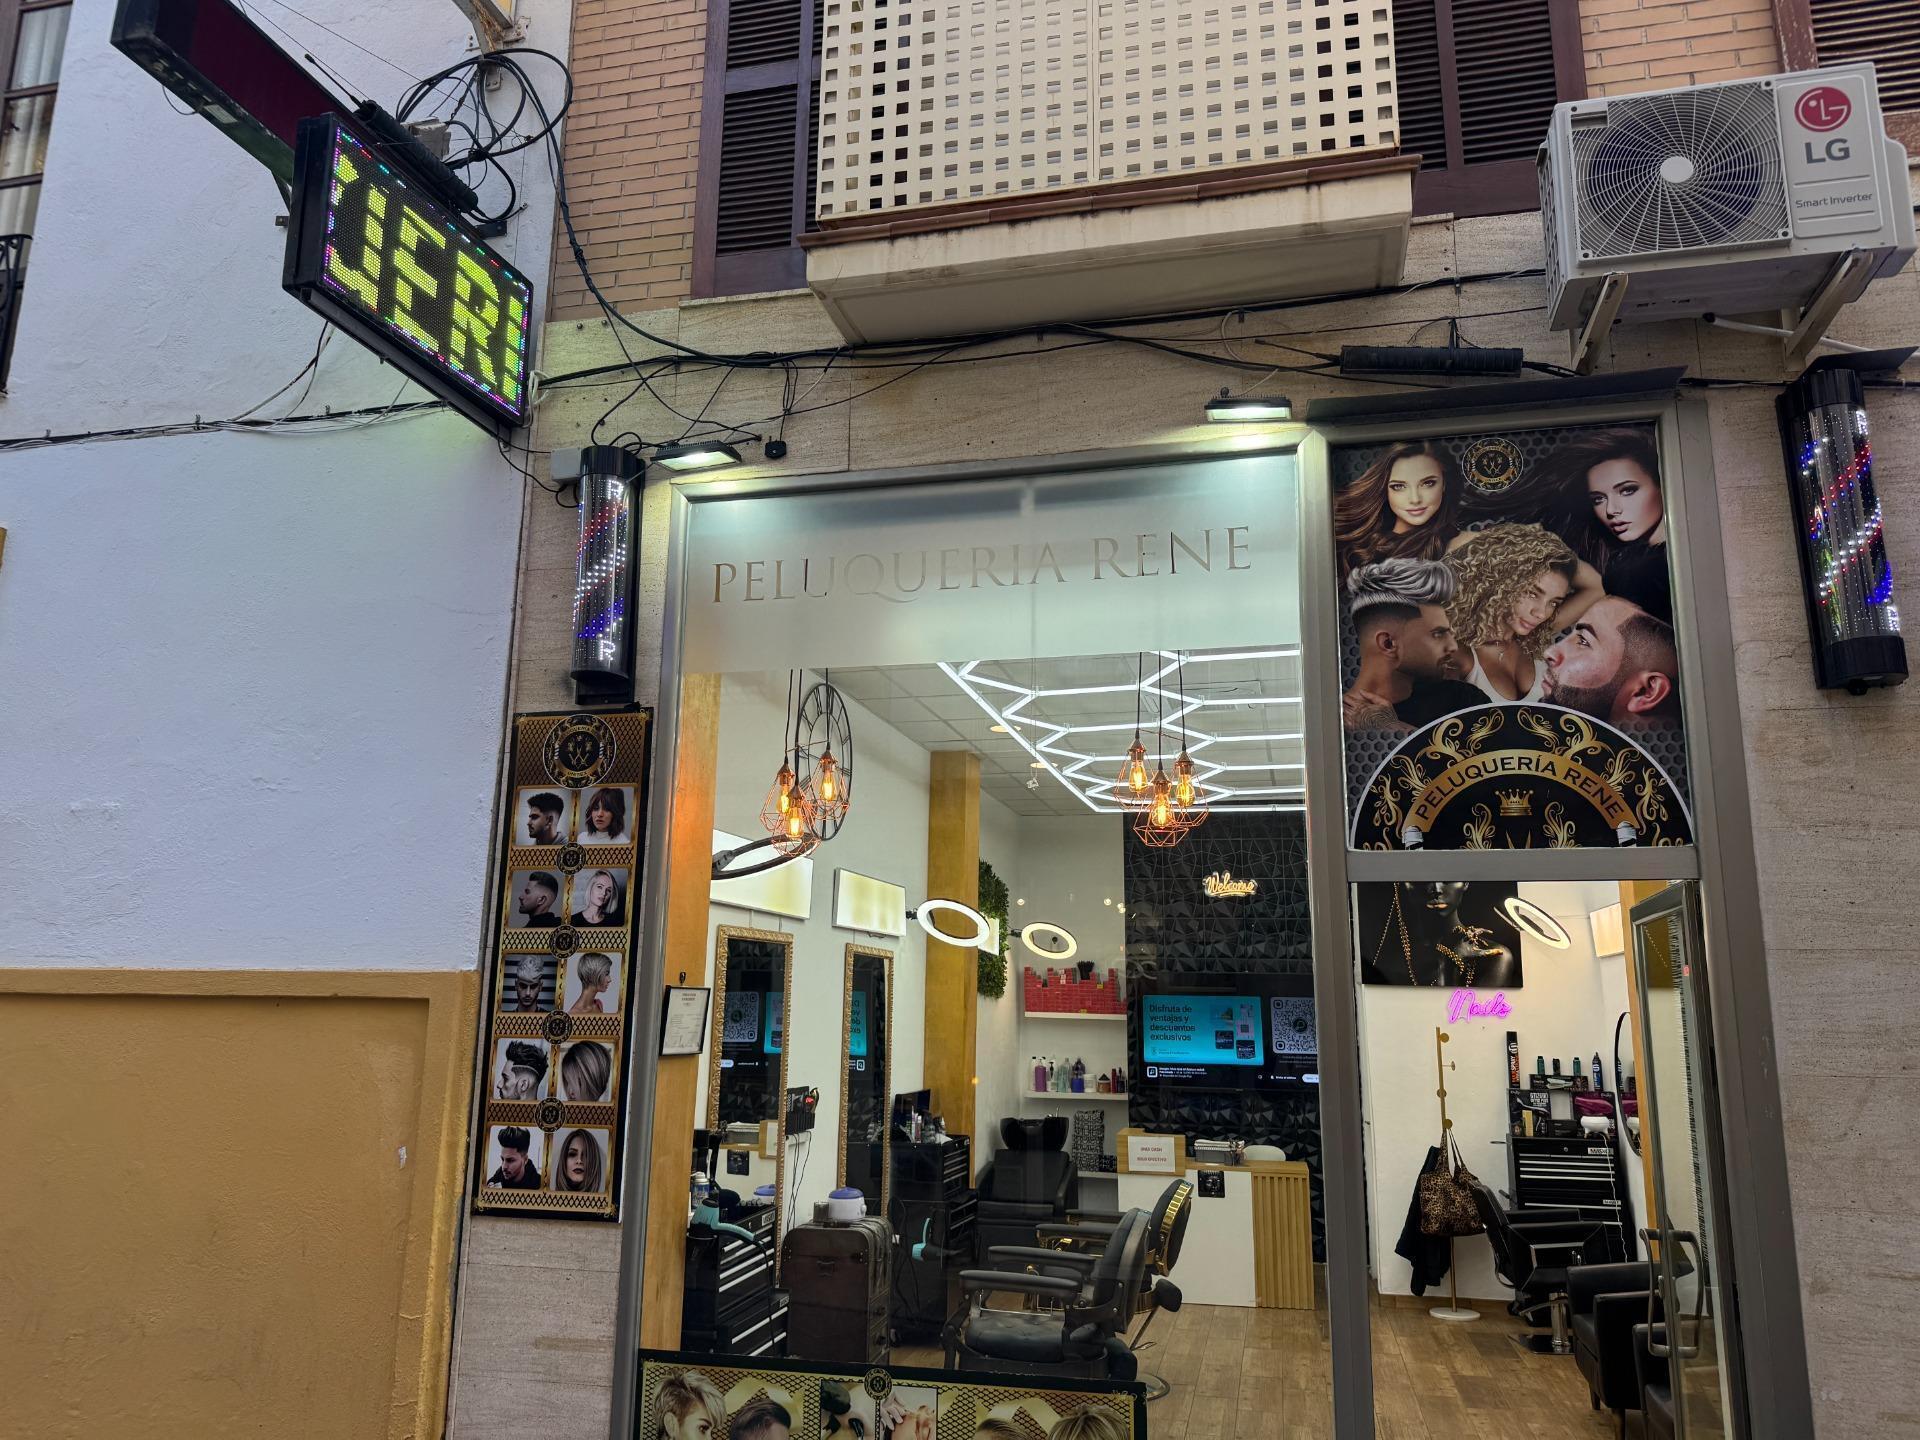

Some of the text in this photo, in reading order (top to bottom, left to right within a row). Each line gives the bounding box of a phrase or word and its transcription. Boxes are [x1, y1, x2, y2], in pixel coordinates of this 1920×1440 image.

[1804, 138, 1850, 164] LG
[1795, 192, 1873, 208] Smart Inverter
[712, 525, 1252, 604] PELUQUERIA RENE
[1415, 755, 1625, 821] PELUQUERÍA RENE
[1149, 1004, 1192, 1013] Disfruta de
[1448, 988, 1512, 1024] Nails
[1150, 1014, 1182, 1023] ventajas
[1150, 1033, 1192, 1041] exclusivos
